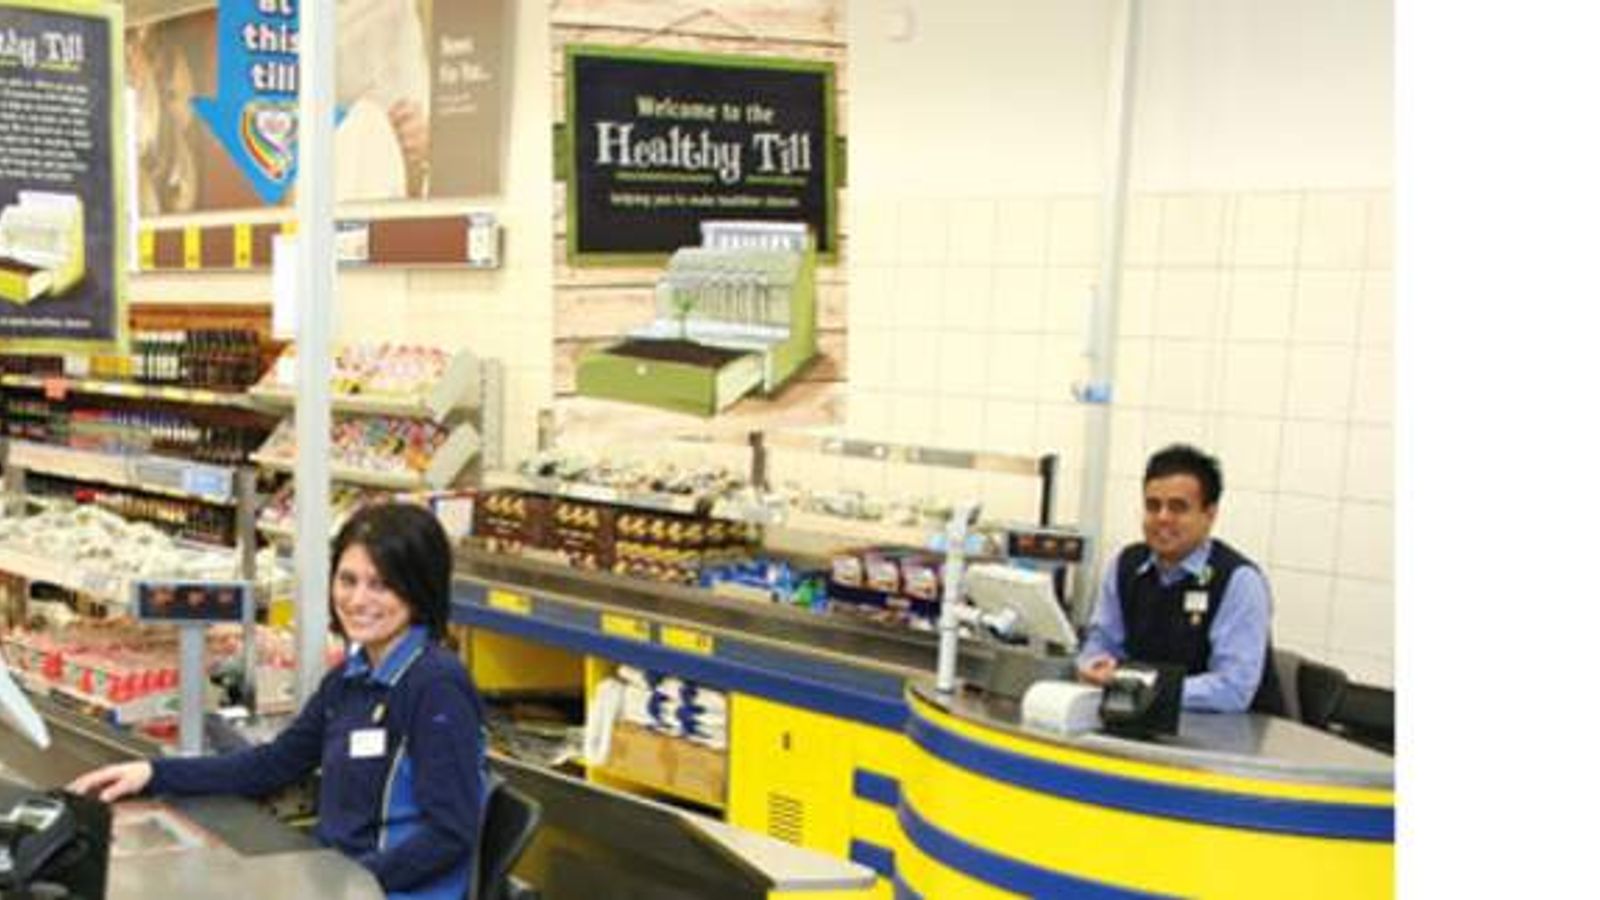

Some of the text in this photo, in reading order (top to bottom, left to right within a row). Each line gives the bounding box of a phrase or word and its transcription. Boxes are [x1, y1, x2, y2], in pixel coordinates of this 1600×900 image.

[241, 23, 301, 52] this
[251, 61, 296, 91] till
[636, 96, 775, 125] Welcome to the
[594, 121, 812, 183] Healthy Till
